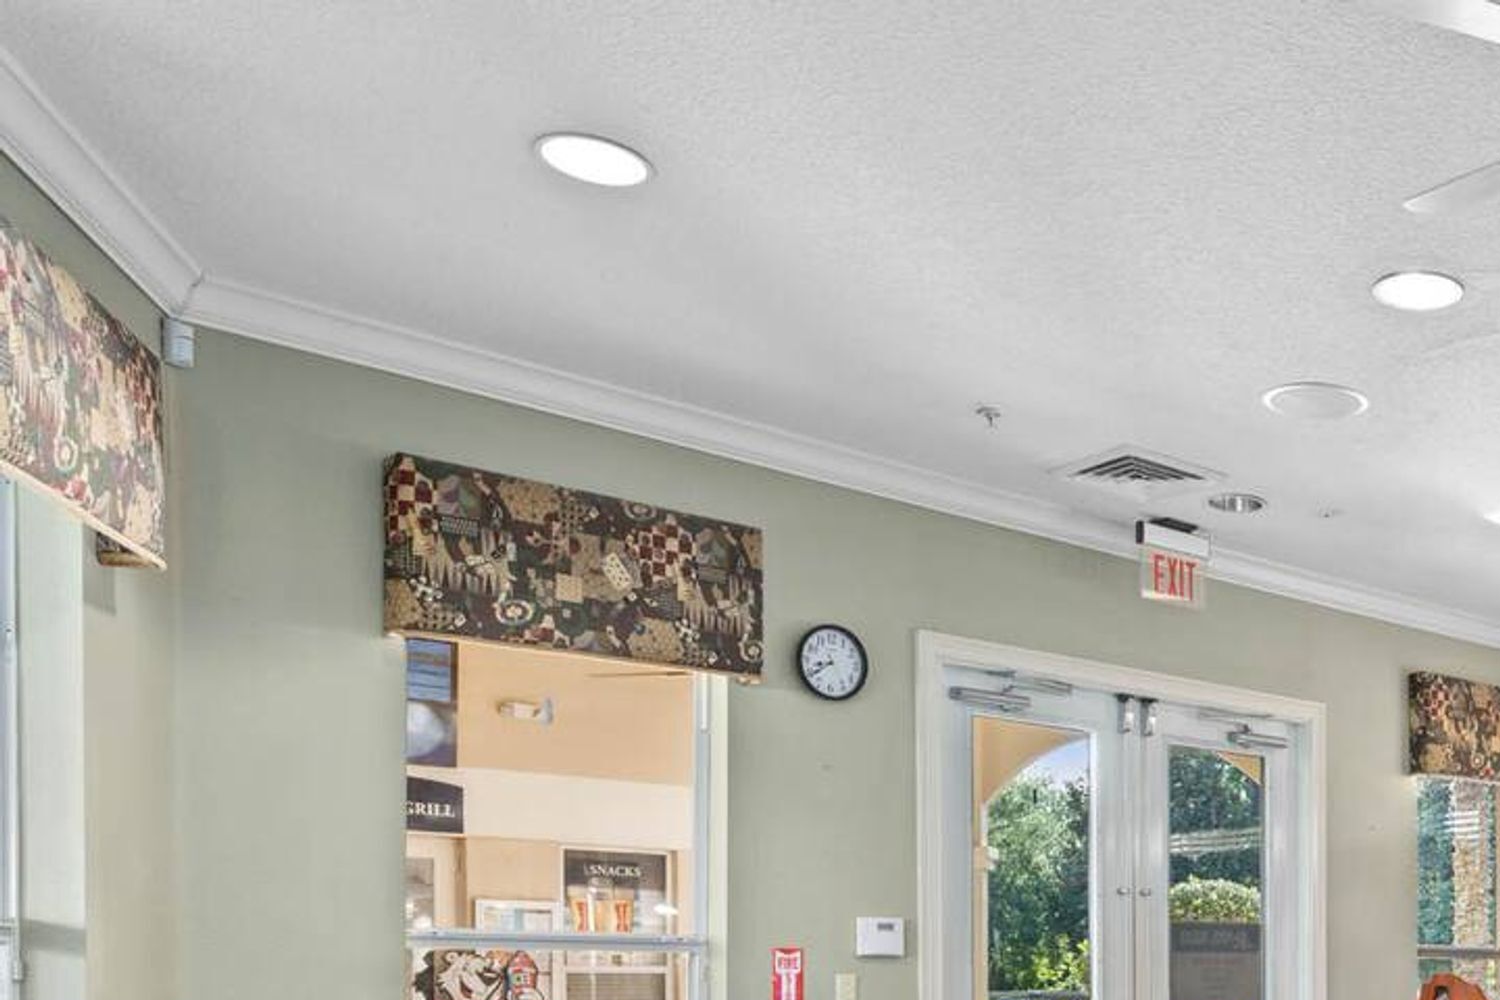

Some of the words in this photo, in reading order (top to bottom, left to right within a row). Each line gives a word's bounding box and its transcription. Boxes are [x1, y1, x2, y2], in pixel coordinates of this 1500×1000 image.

[1153, 553, 1197, 601] EXIT
[404, 801, 456, 818] GRILL
[587, 863, 642, 878] SNACKS
[777, 956, 800, 970] FIRE
